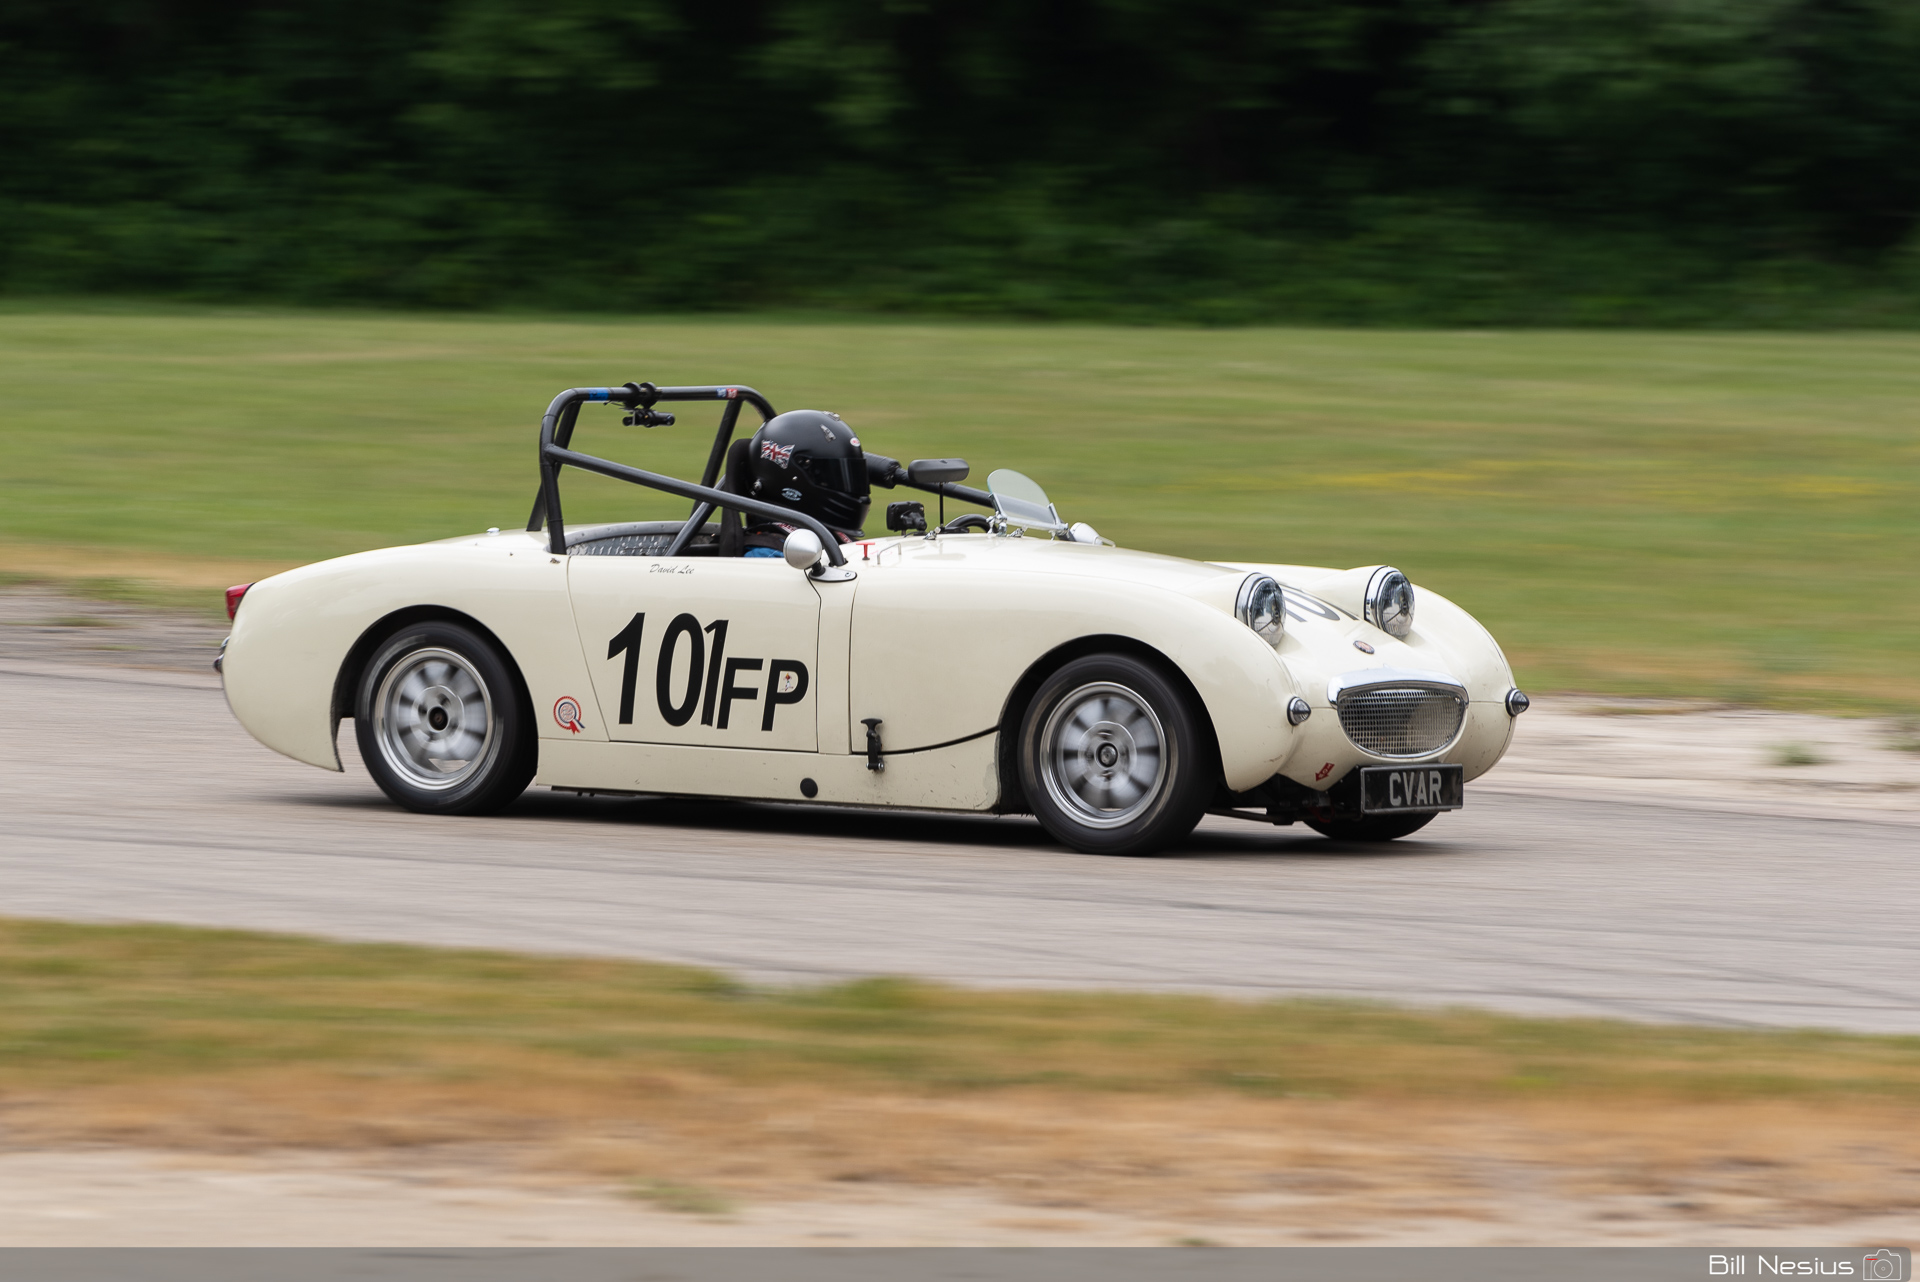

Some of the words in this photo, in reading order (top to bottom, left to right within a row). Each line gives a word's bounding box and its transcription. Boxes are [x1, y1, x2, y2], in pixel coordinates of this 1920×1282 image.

[649, 563, 678, 574] David
[677, 564, 695, 574] Lee
[1389, 770, 1442, 806] CVAR
